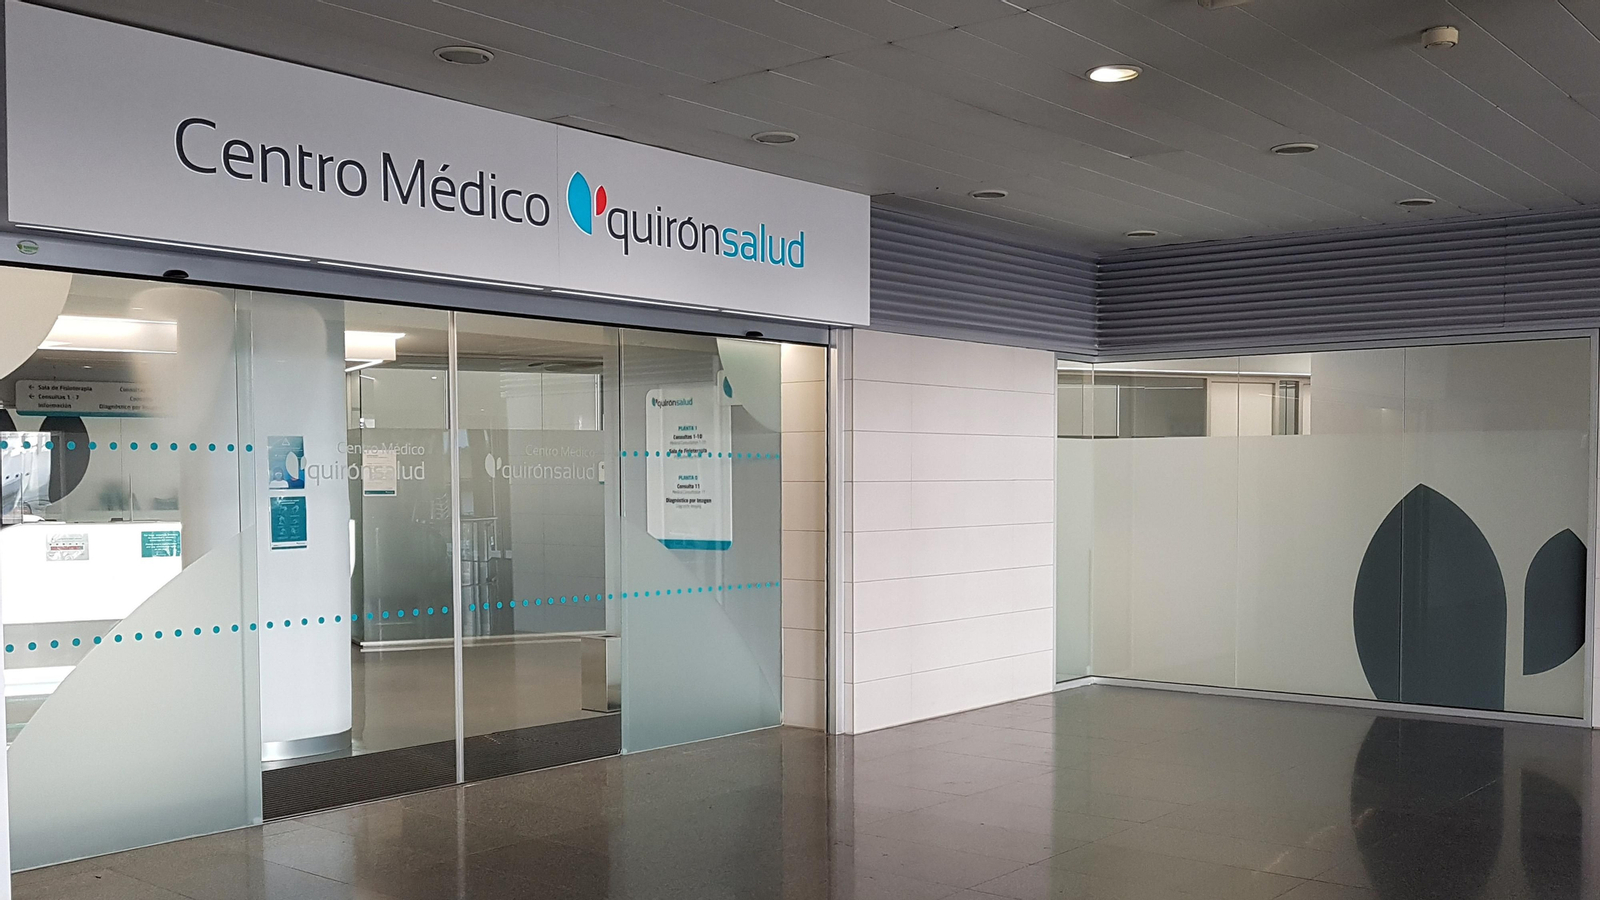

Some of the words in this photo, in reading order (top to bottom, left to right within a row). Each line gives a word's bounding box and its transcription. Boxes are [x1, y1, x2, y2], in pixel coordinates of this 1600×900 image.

[174, 117, 368, 198] Centro
[381, 151, 551, 227] Médico
[607, 205, 805, 269] quirónsalud
[337, 441, 379, 455] Centro
[381, 442, 425, 456] Médico
[525, 444, 559, 457] Centro
[307, 460, 426, 487] quirónsalud
[502, 461, 596, 485] quirónsalud
